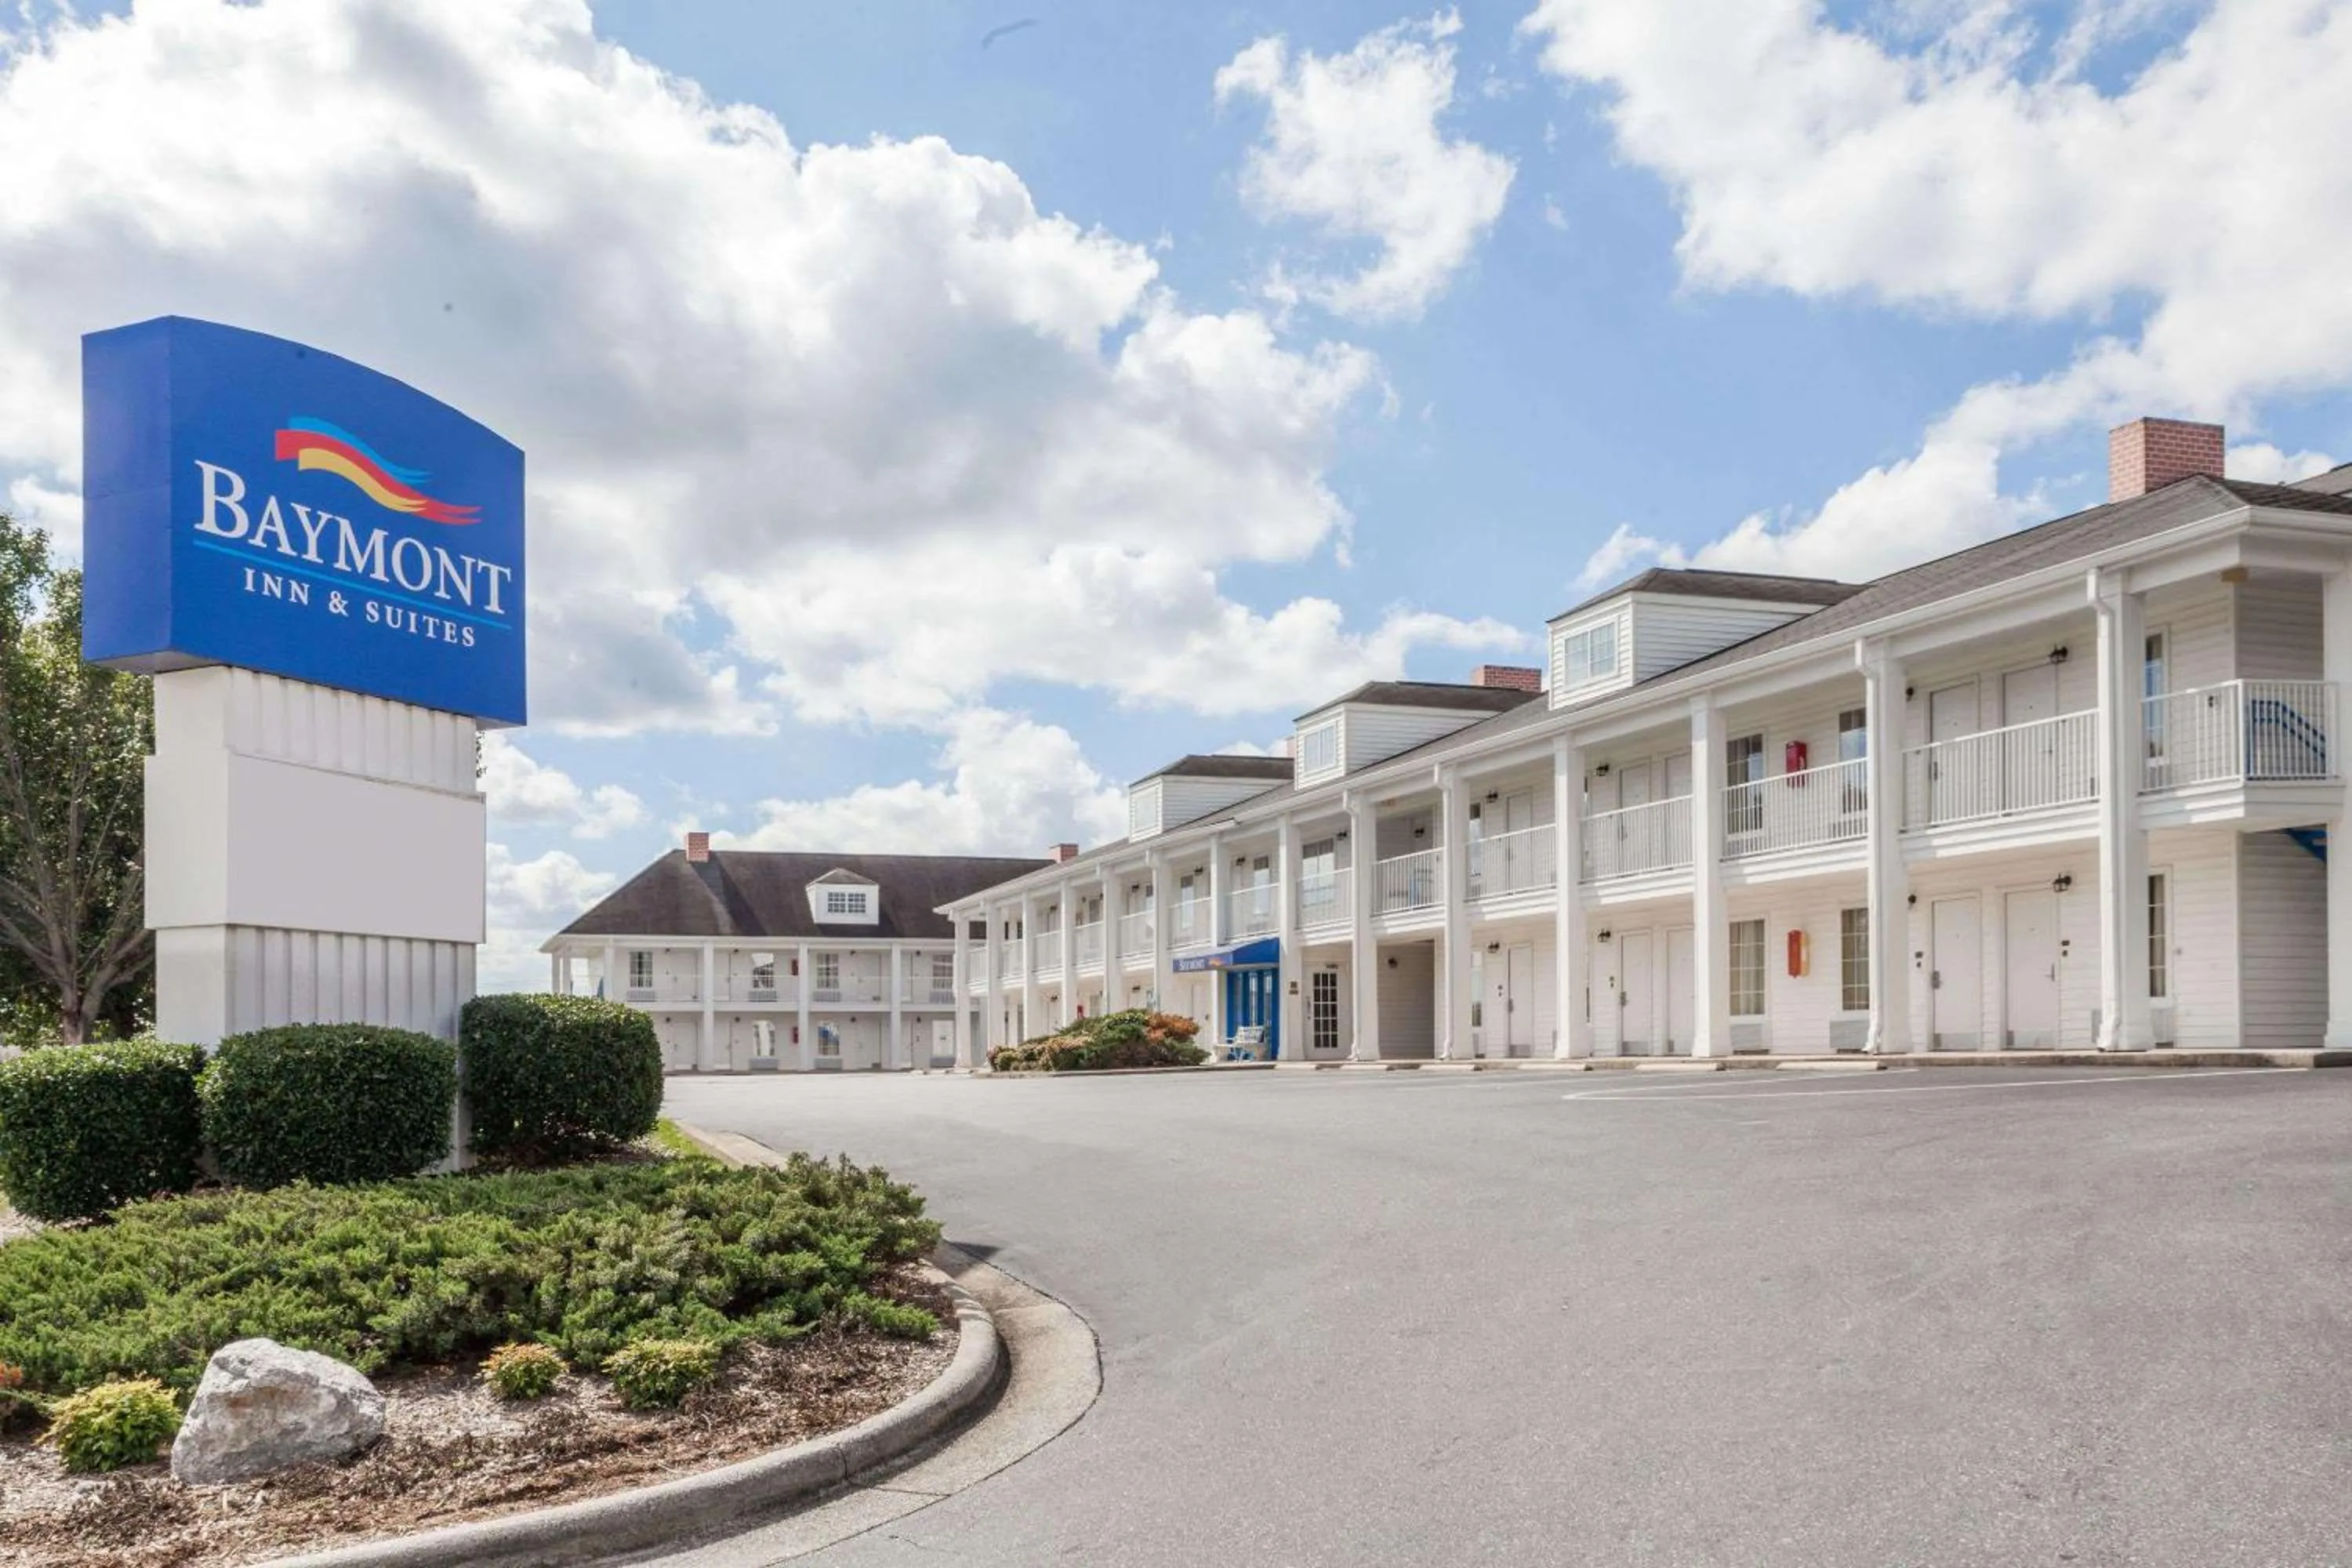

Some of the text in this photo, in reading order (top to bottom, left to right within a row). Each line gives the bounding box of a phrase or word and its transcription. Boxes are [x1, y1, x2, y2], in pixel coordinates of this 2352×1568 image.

[194, 459, 511, 615] BAYMONT
[245, 568, 475, 647] INN & SUITES
